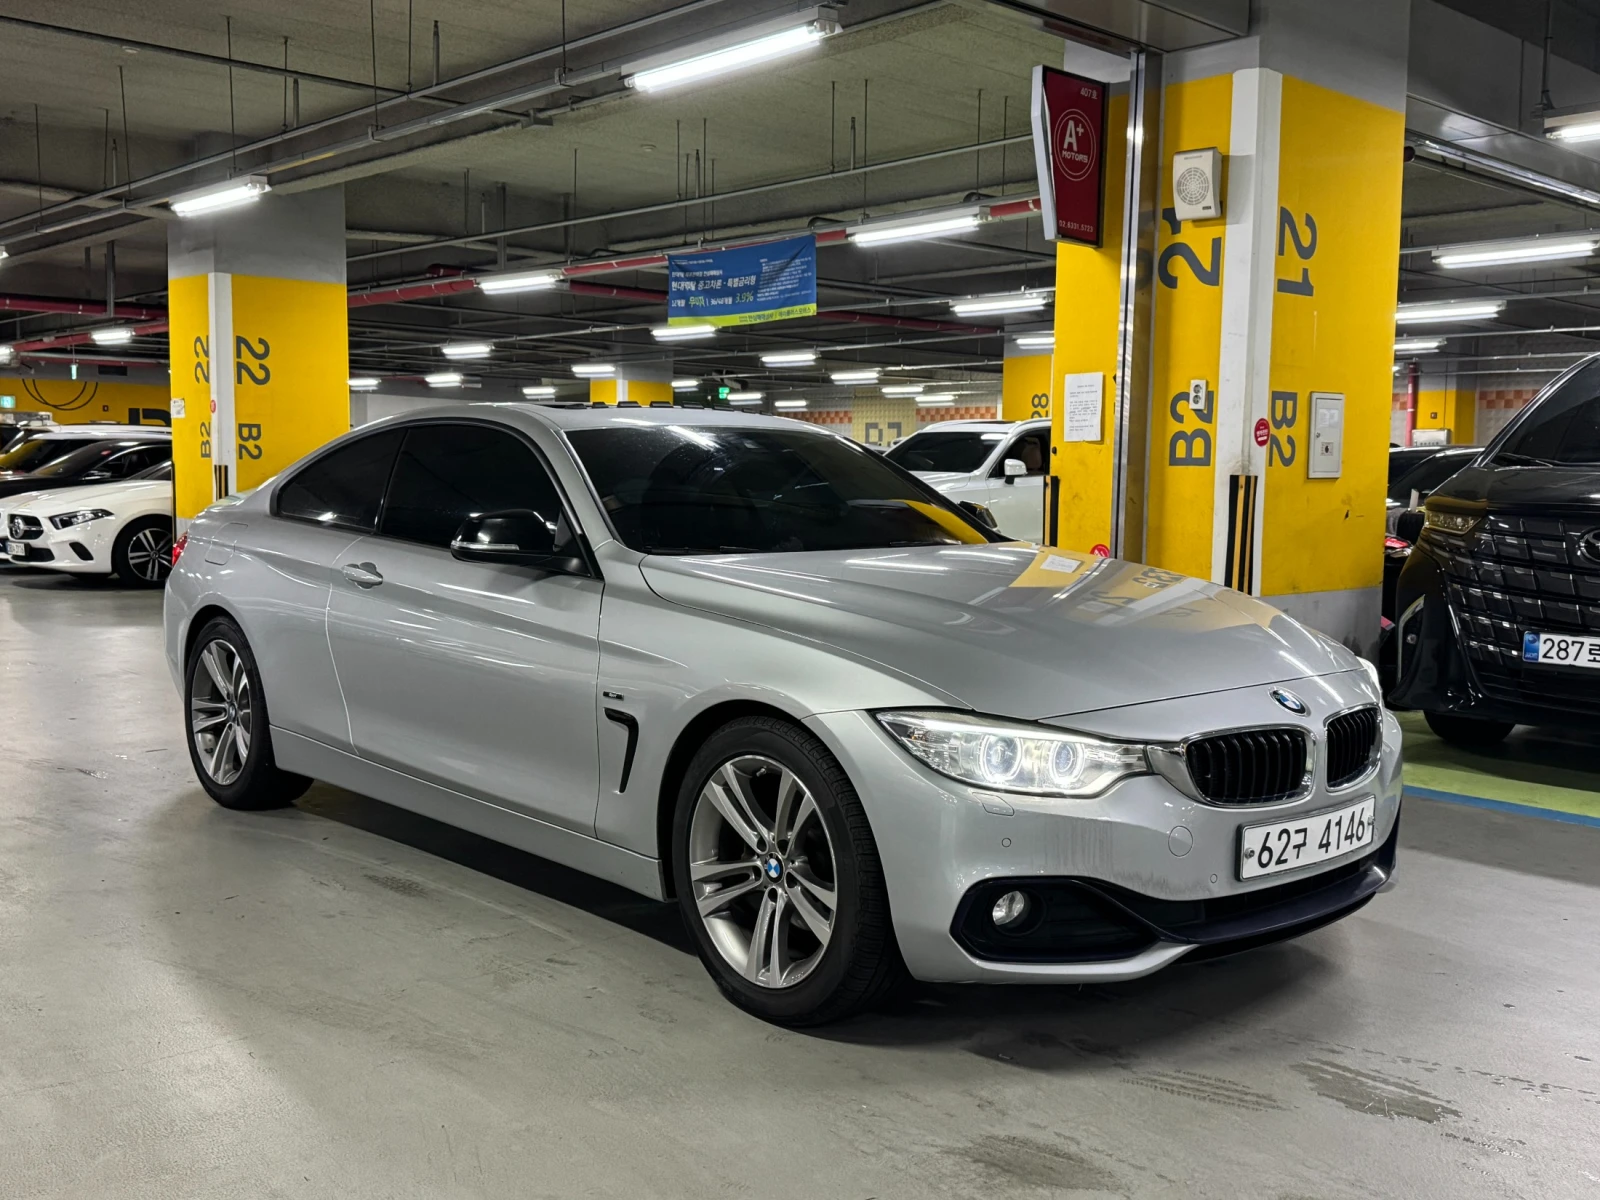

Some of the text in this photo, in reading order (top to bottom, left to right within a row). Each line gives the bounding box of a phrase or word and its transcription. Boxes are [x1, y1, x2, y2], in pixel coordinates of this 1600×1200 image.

[1080, 87, 1098, 100] 407호
[1062, 150, 1088, 163] MOTORS
[1063, 119, 1084, 151] A+
[1277, 206, 1317, 296] 21
[735, 291, 754, 304] 3.9%
[194, 335, 209, 384] 22
[236, 335, 271, 386] 22
[200, 421, 212, 458] B2
[238, 423, 263, 460] B2
[1169, 390, 1215, 466] B2
[1268, 391, 1298, 467] B2
[1257, 807, 1366, 869] 62구 4146
